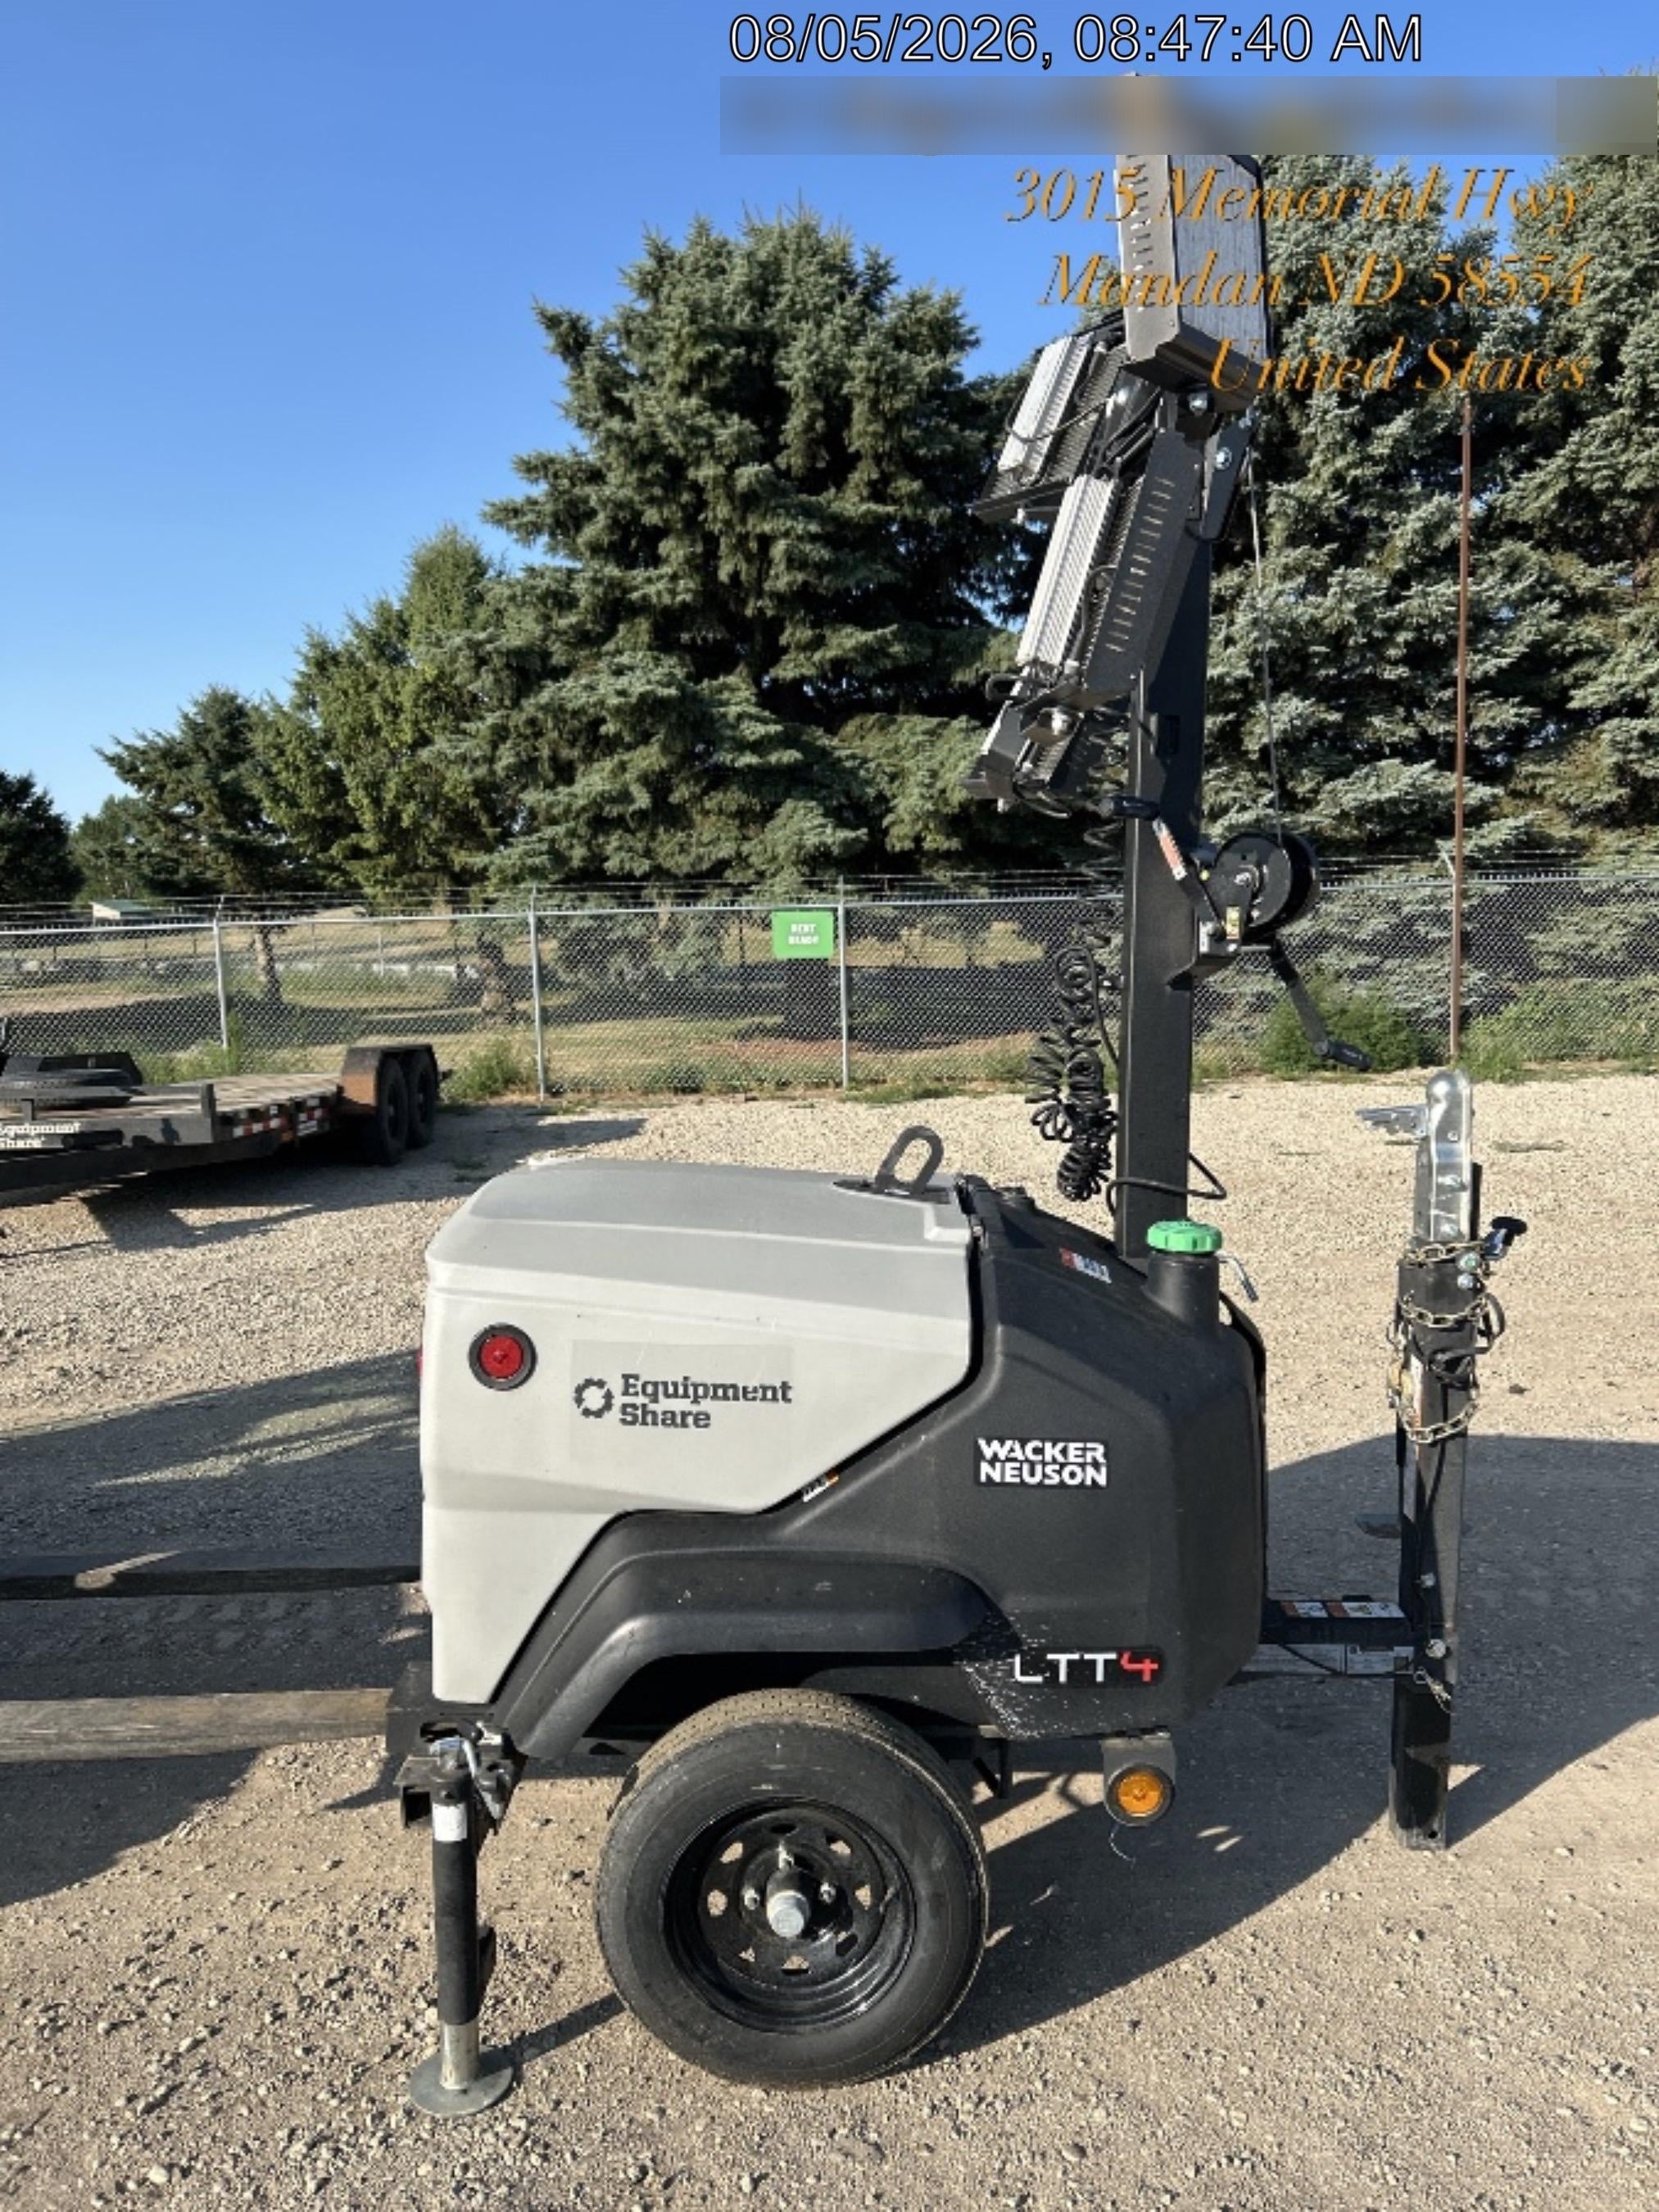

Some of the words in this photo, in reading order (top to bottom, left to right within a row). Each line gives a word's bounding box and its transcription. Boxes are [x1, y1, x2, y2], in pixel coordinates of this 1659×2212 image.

[620, 1373, 793, 1404] Equipment
[619, 1403, 711, 1429] Share
[977, 1438, 1106, 1462] WACKER
[979, 1462, 1107, 1488] NEUSON
[1013, 1651, 1158, 1684] LTT4
